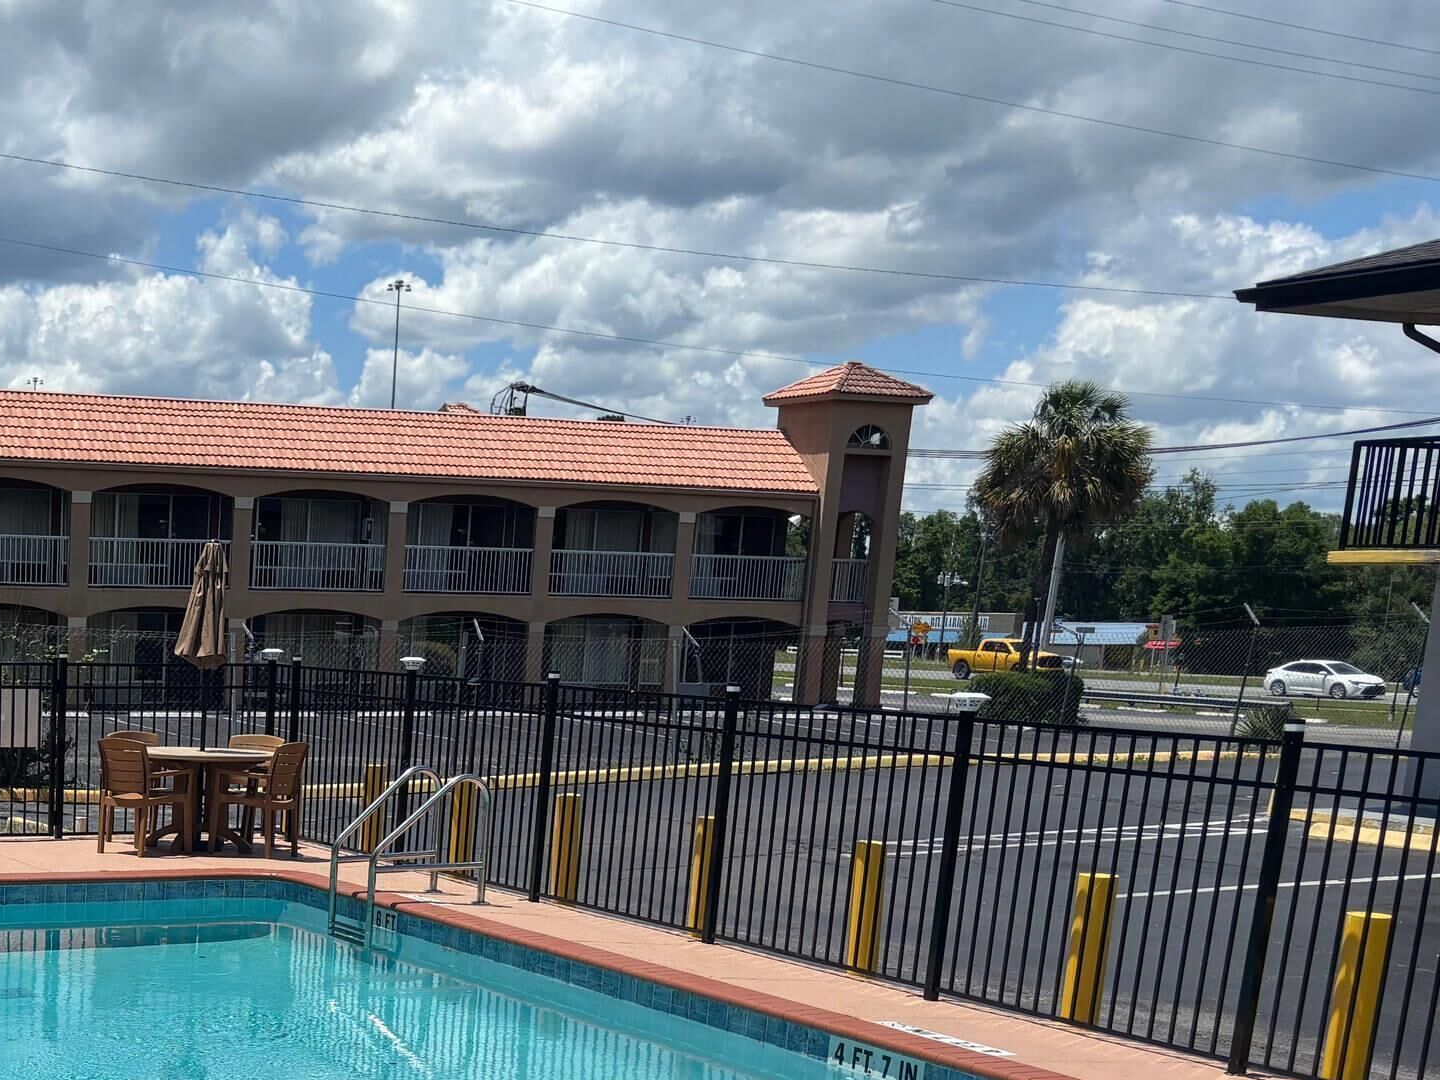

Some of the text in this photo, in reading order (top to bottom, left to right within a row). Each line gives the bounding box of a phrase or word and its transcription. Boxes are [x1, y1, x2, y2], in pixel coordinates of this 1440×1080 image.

[834, 1042, 845, 1066] 4
[851, 1047, 873, 1075] FT.
[881, 1054, 892, 1079] 7
